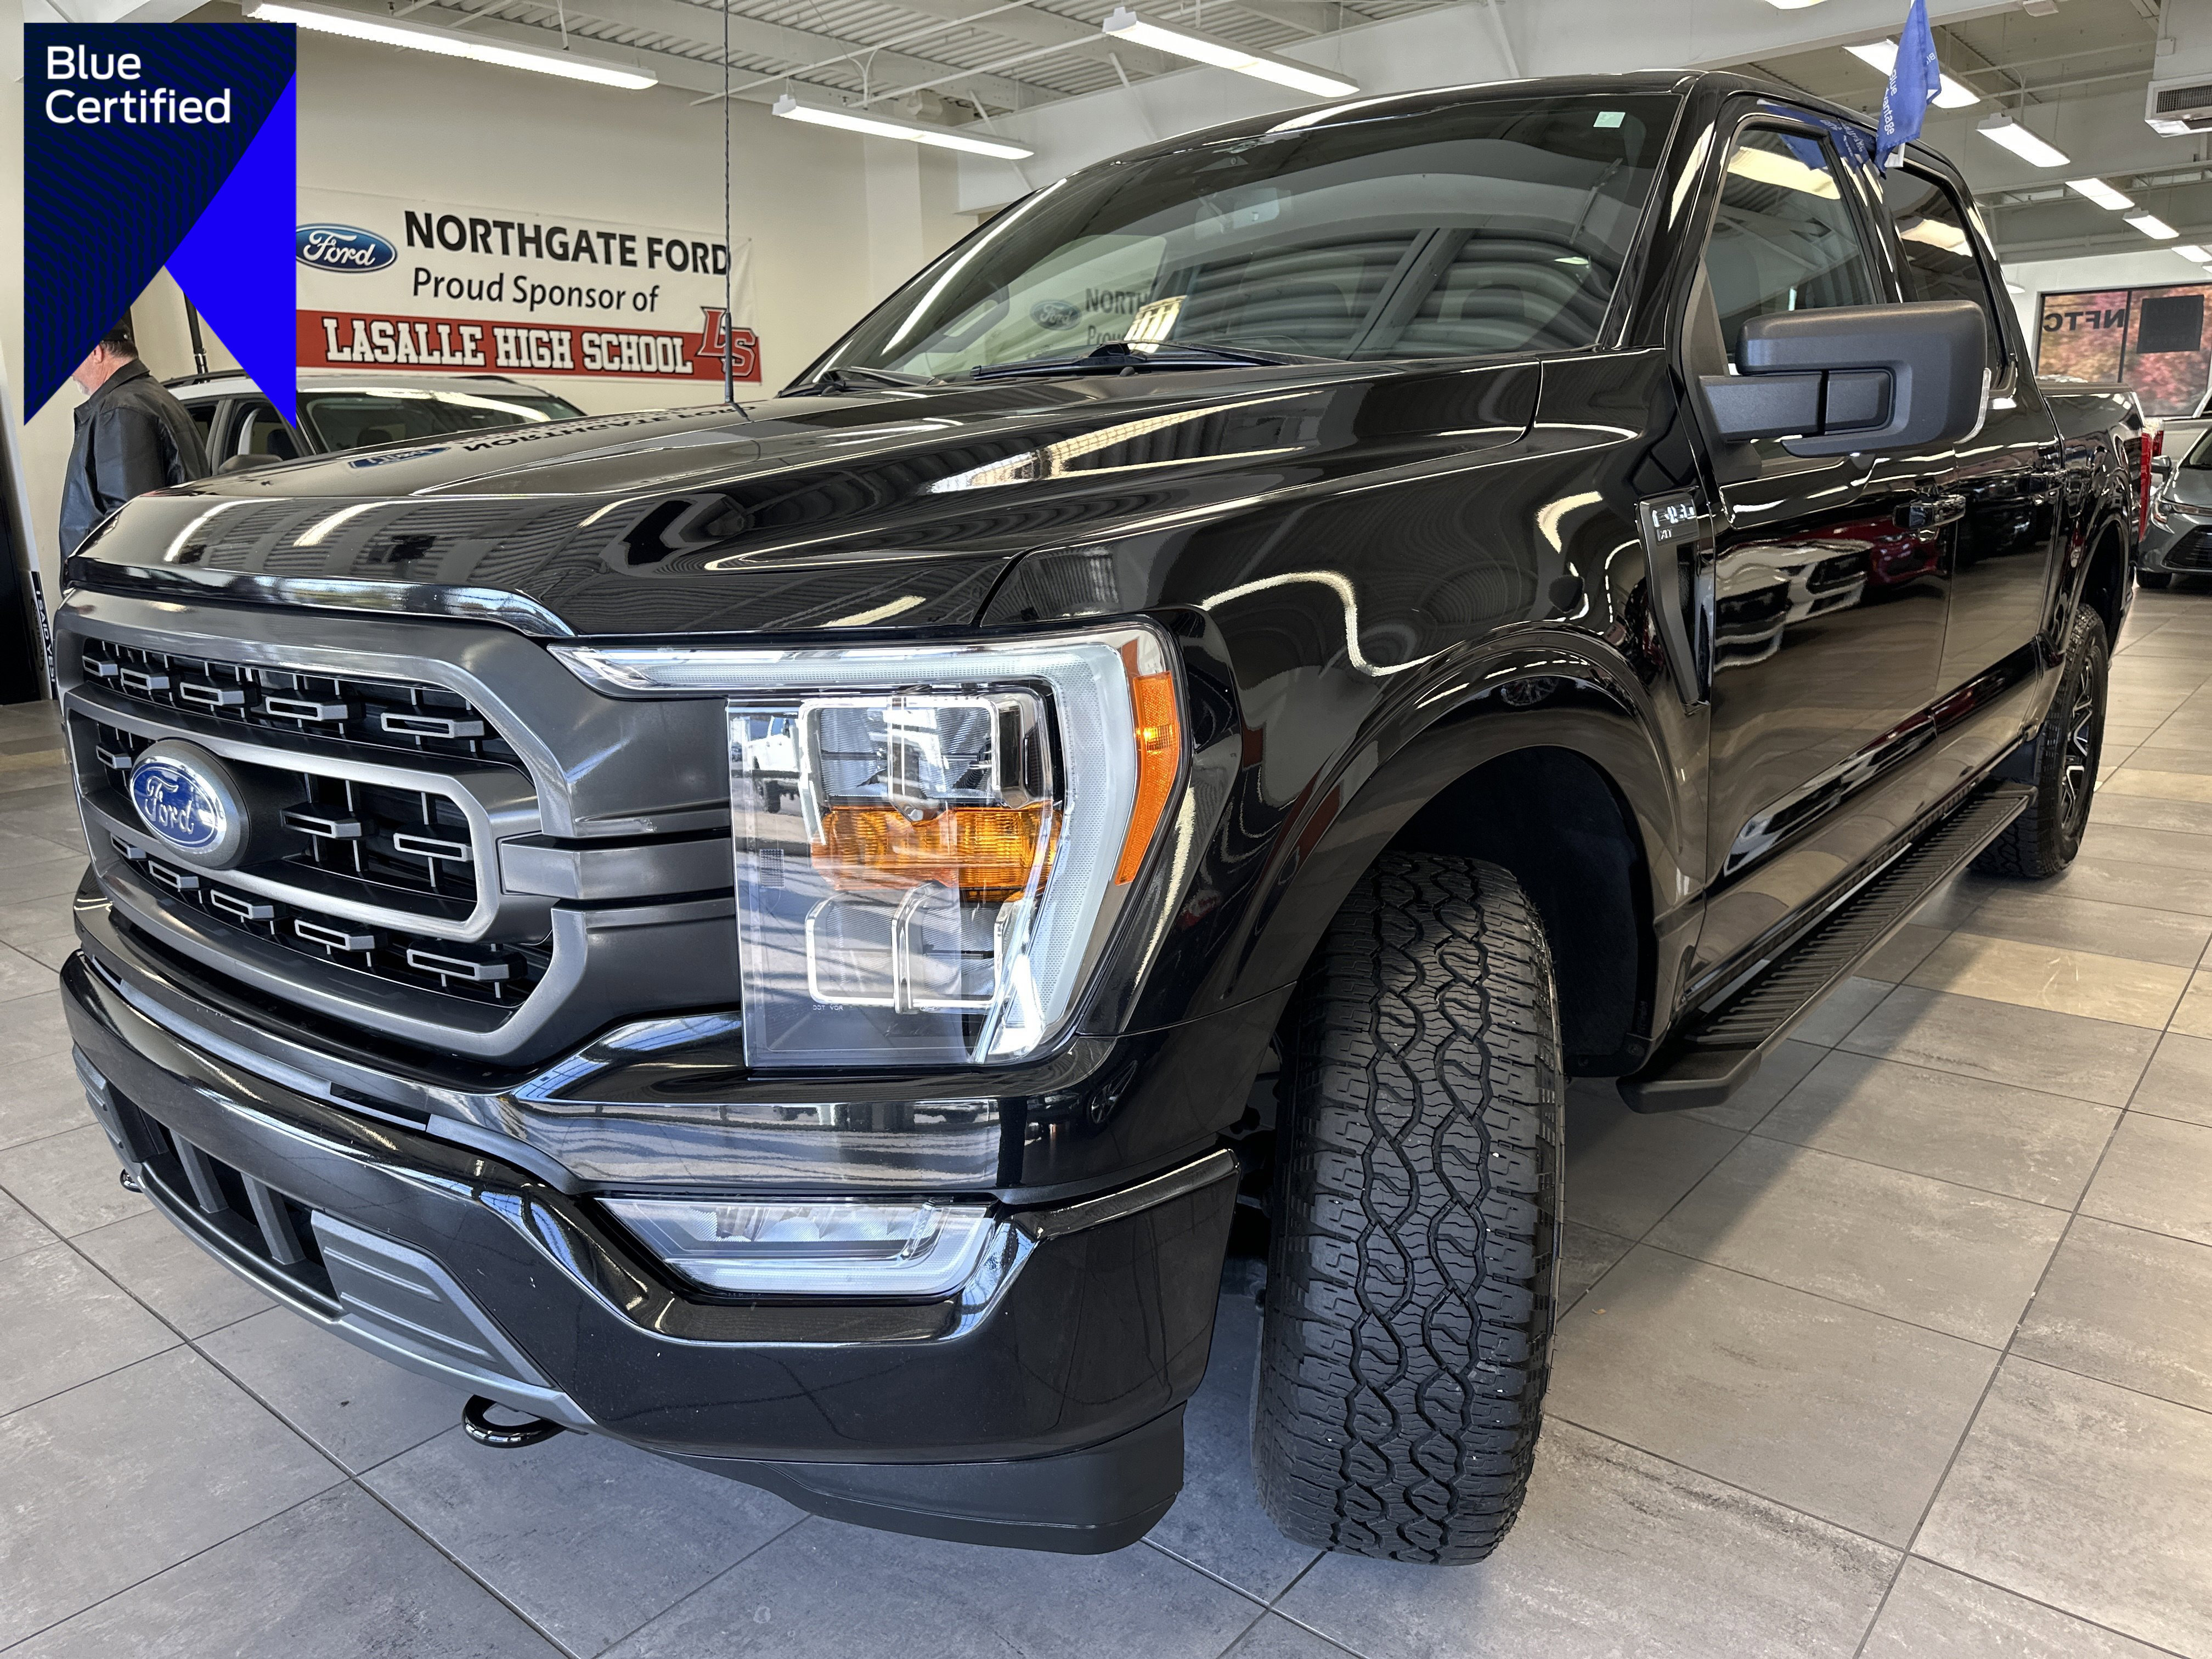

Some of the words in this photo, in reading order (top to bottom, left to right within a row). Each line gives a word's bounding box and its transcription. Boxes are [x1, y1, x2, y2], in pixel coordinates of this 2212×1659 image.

[303, 229, 376, 267] Ford
[404, 211, 638, 268] NORTHGATE
[647, 238, 731, 276] FORD
[413, 267, 505, 303] Proud
[512, 276, 626, 312] Sponsor
[632, 285, 660, 313] of
[321, 317, 487, 367] LASALLE
[492, 328, 575, 371] HIGH
[582, 332, 694, 375] SCHOOL
[145, 776, 194, 834] Ford
